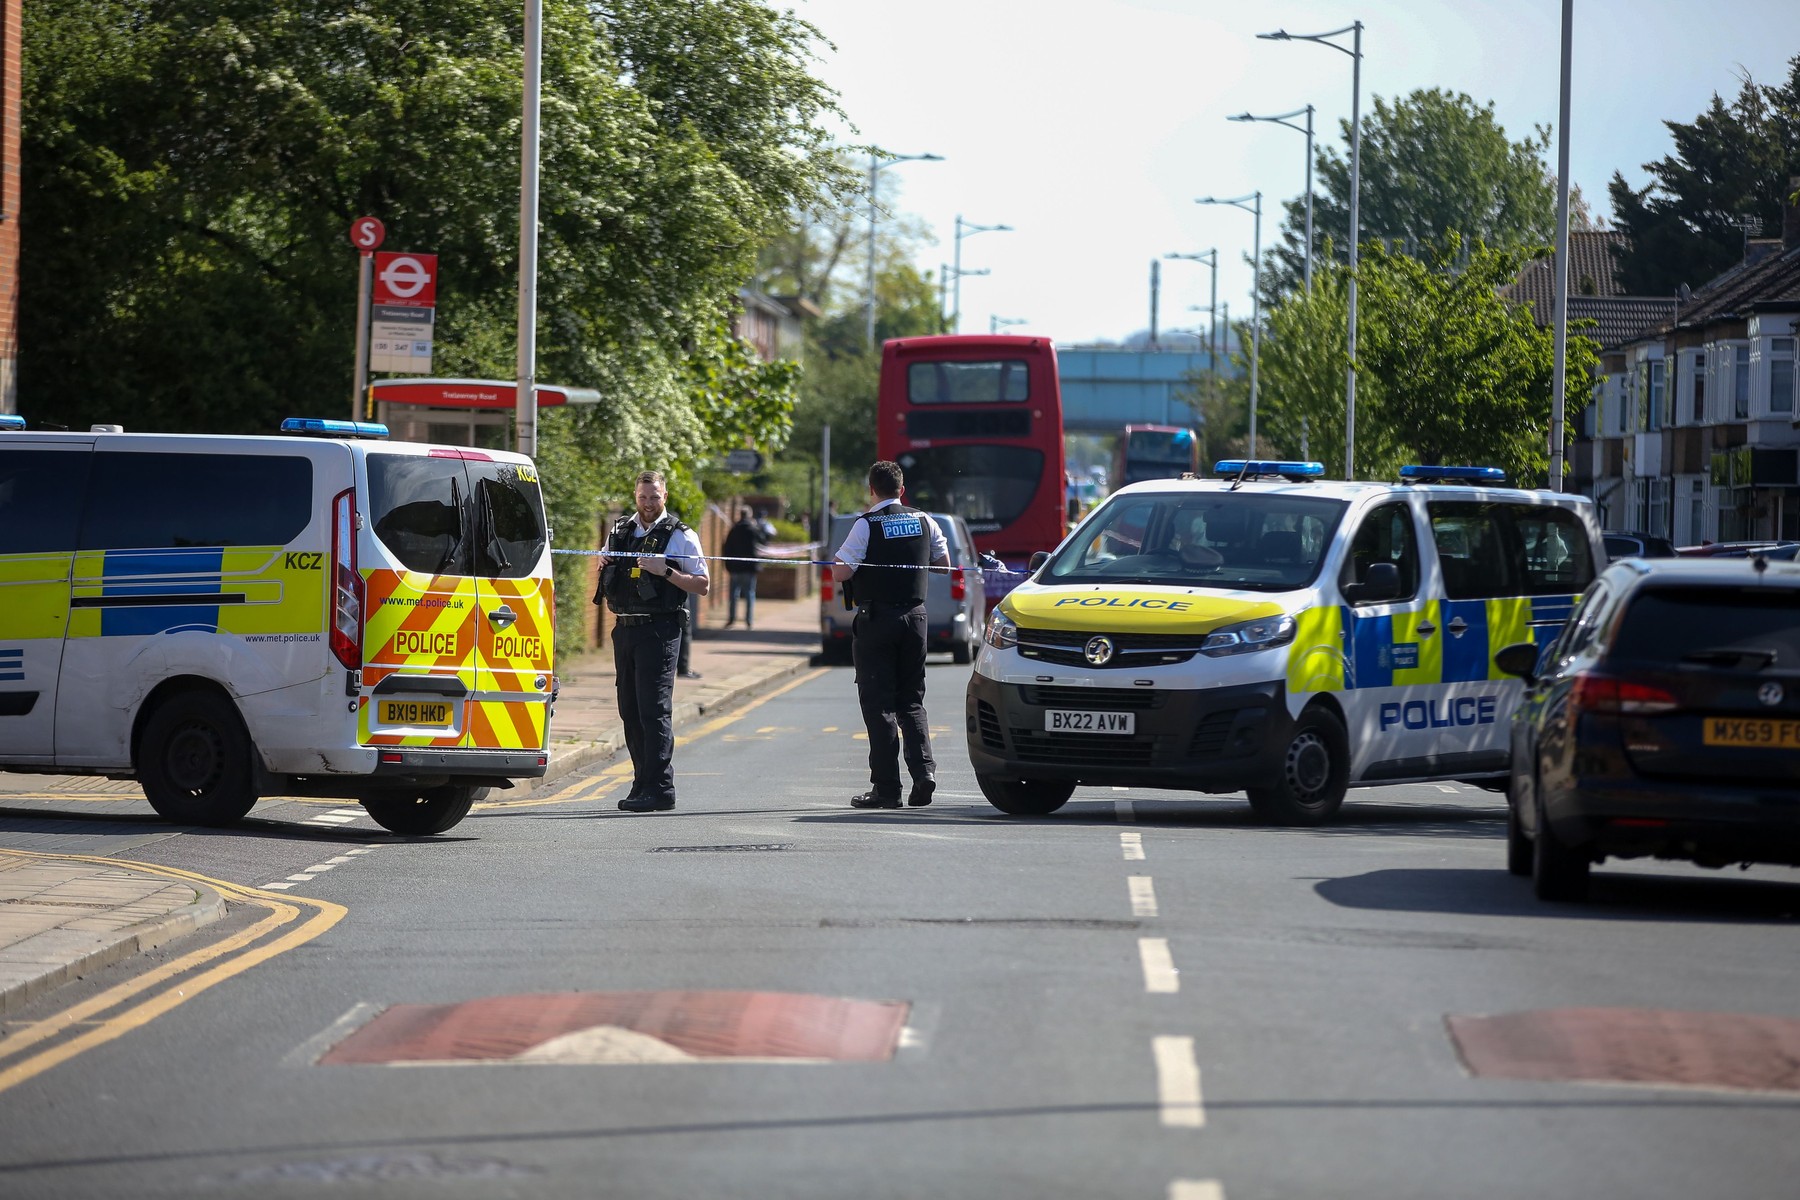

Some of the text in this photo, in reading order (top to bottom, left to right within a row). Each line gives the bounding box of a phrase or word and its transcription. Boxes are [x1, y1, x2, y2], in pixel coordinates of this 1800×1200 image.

[359, 222, 376, 246] S
[516, 465, 537, 483] KCZ
[885, 524, 921, 537] POLICE
[285, 552, 323, 570] KCZ
[379, 595, 464, 610] www.met.police.uk
[1054, 597, 1194, 612] POLICE
[245, 633, 321, 644] www.met.police.uk
[396, 632, 455, 655] POLICE
[494, 636, 541, 659] POLICE
[387, 703, 446, 722] BX19 HKD
[1052, 712, 1128, 731] BX22 AVW
[1380, 695, 1497, 732] POLICE
